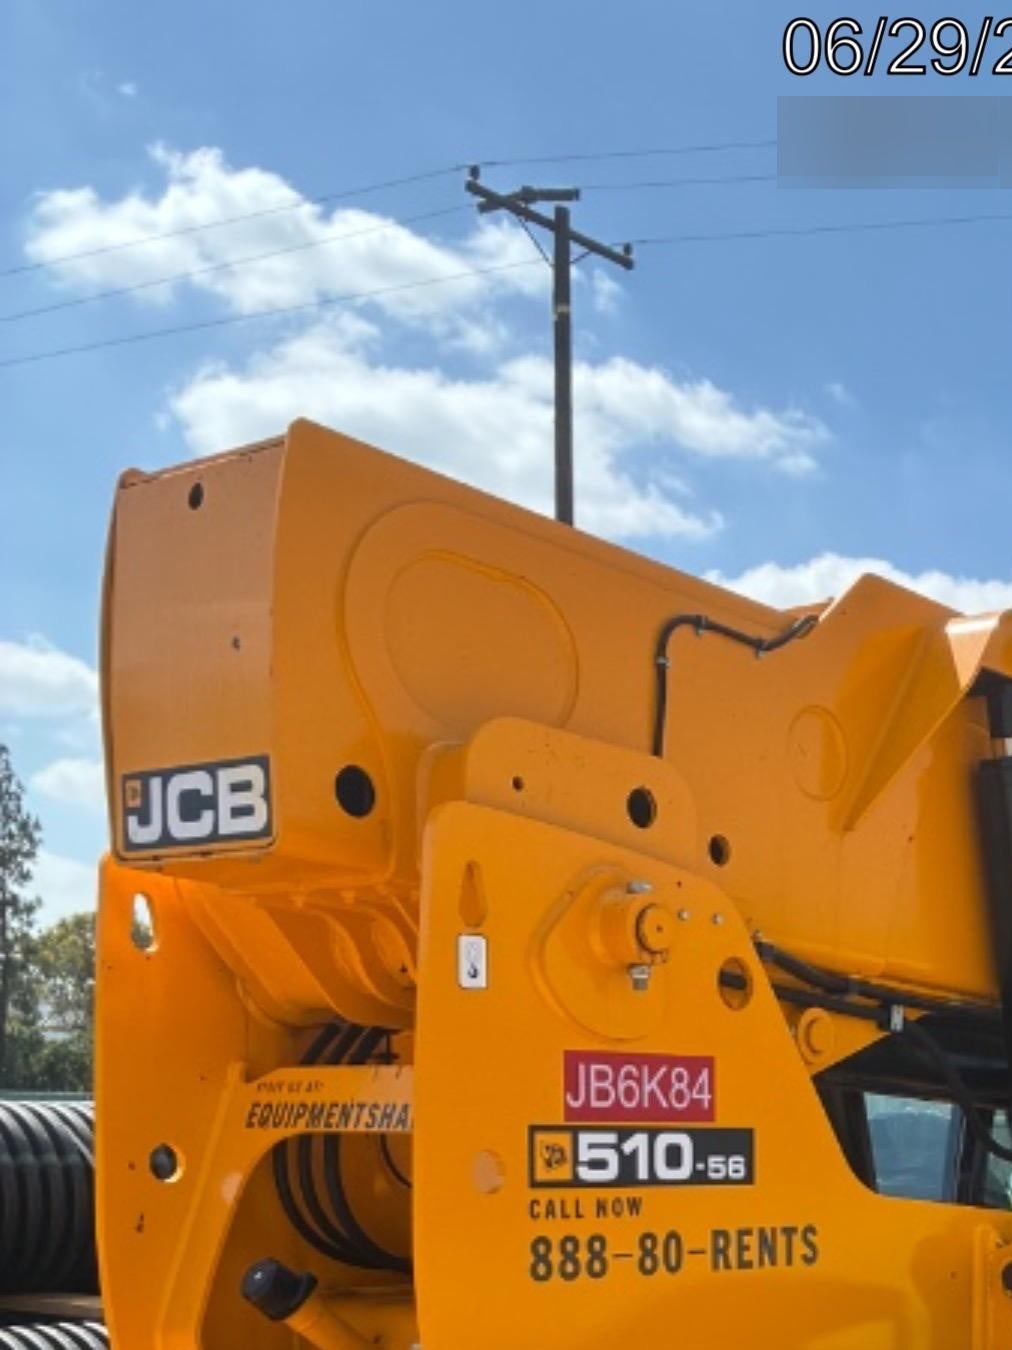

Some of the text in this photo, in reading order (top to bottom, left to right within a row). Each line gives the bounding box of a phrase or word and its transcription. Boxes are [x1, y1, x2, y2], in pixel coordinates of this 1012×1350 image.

[126, 763, 269, 844] JCB
[566, 1062, 712, 1110] JB6K84
[245, 1102, 414, 1130] EQUIPMENTSHA
[575, 1130, 747, 1183] 510-56
[528, 1196, 643, 1220] CALL NOW
[528, 1223, 819, 1283] 888-80-RENTS
